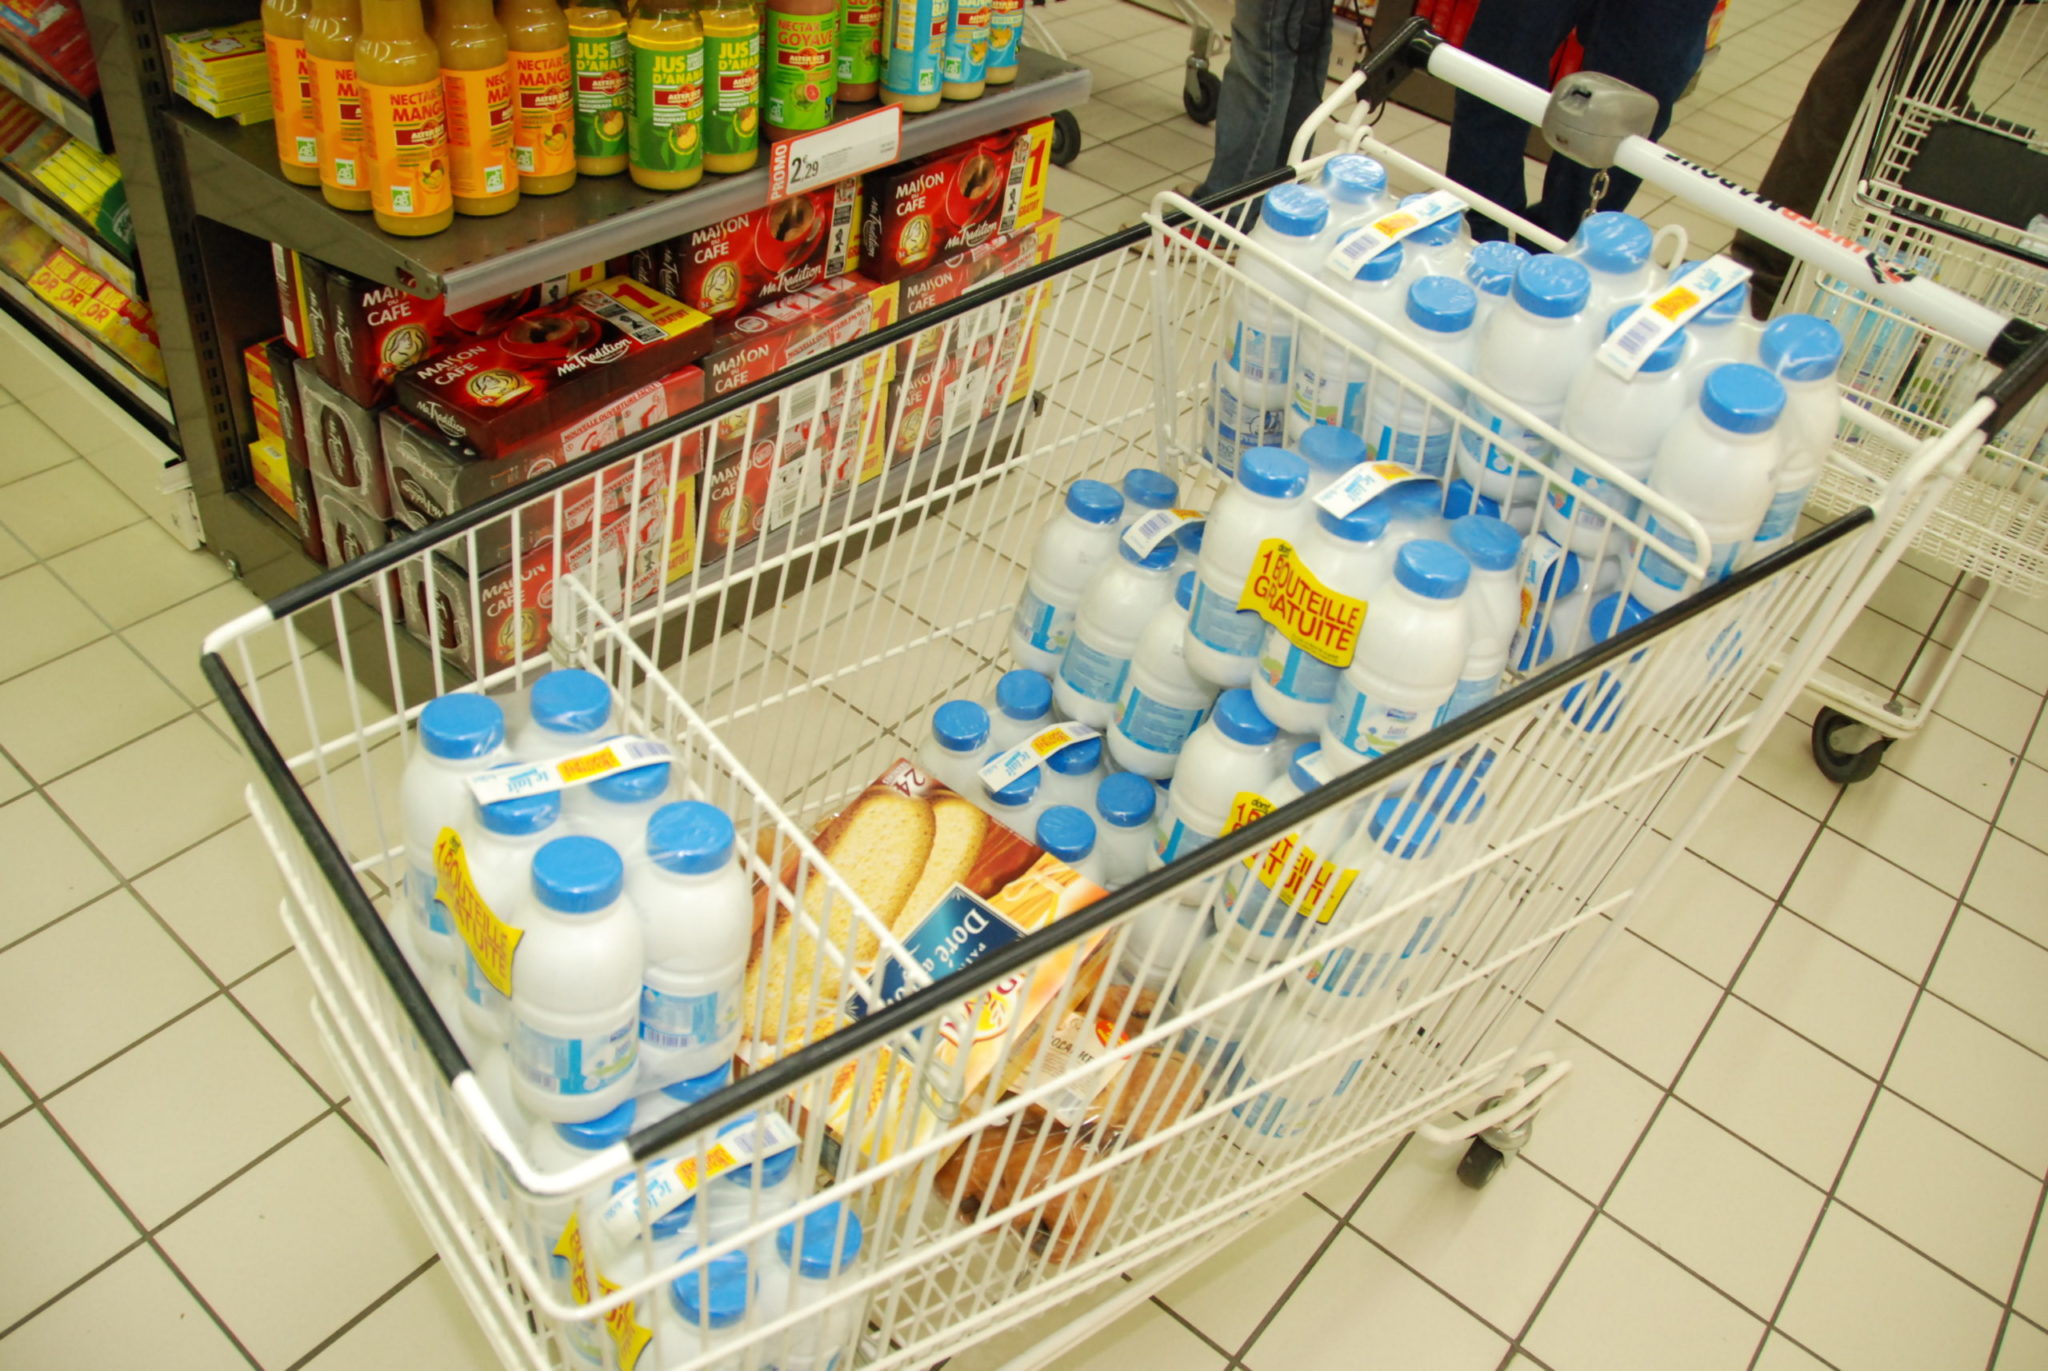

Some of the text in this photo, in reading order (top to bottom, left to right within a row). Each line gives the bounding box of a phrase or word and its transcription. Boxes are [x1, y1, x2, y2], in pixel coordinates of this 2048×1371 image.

[576, 43, 608, 59] JUS
[719, 42, 748, 59] JUS
[777, 30, 832, 46] GOYAVE
[517, 57, 563, 71] NECTAR
[653, 56, 686, 73] JUS
[389, 88, 437, 106] NECTAR
[771, 144, 787, 201] PROMO
[1029, 137, 1047, 188] 1
[896, 172, 945, 200] MAISON
[897, 196, 927, 216] CAFE
[691, 214, 750, 247] MAISON
[958, 220, 998, 247] Tradition
[694, 241, 730, 265] CAFE
[758, 263, 823, 298] Ma Tradition
[907, 272, 953, 299] MAISON
[58, 288, 85, 308] OR
[611, 283, 661, 309] 1
[908, 294, 936, 315] CAFE
[84, 303, 110, 324] OR
[367, 300, 413, 327] CAFE
[416, 344, 488, 380] MAISON
[556, 337, 634, 377] Ma Tradition
[712, 344, 770, 377] MAISON
[434, 361, 479, 386] CAFE
[715, 371, 749, 394] CAFE
[427, 401, 468, 439] Tradition
[1263, 549, 1361, 629] 1 BOUTEILLE
[1253, 575, 1355, 652] GRATUITE
[893, 767, 926, 798] 24
[1236, 802, 1247, 823] 1
[934, 908, 990, 969] Doré
